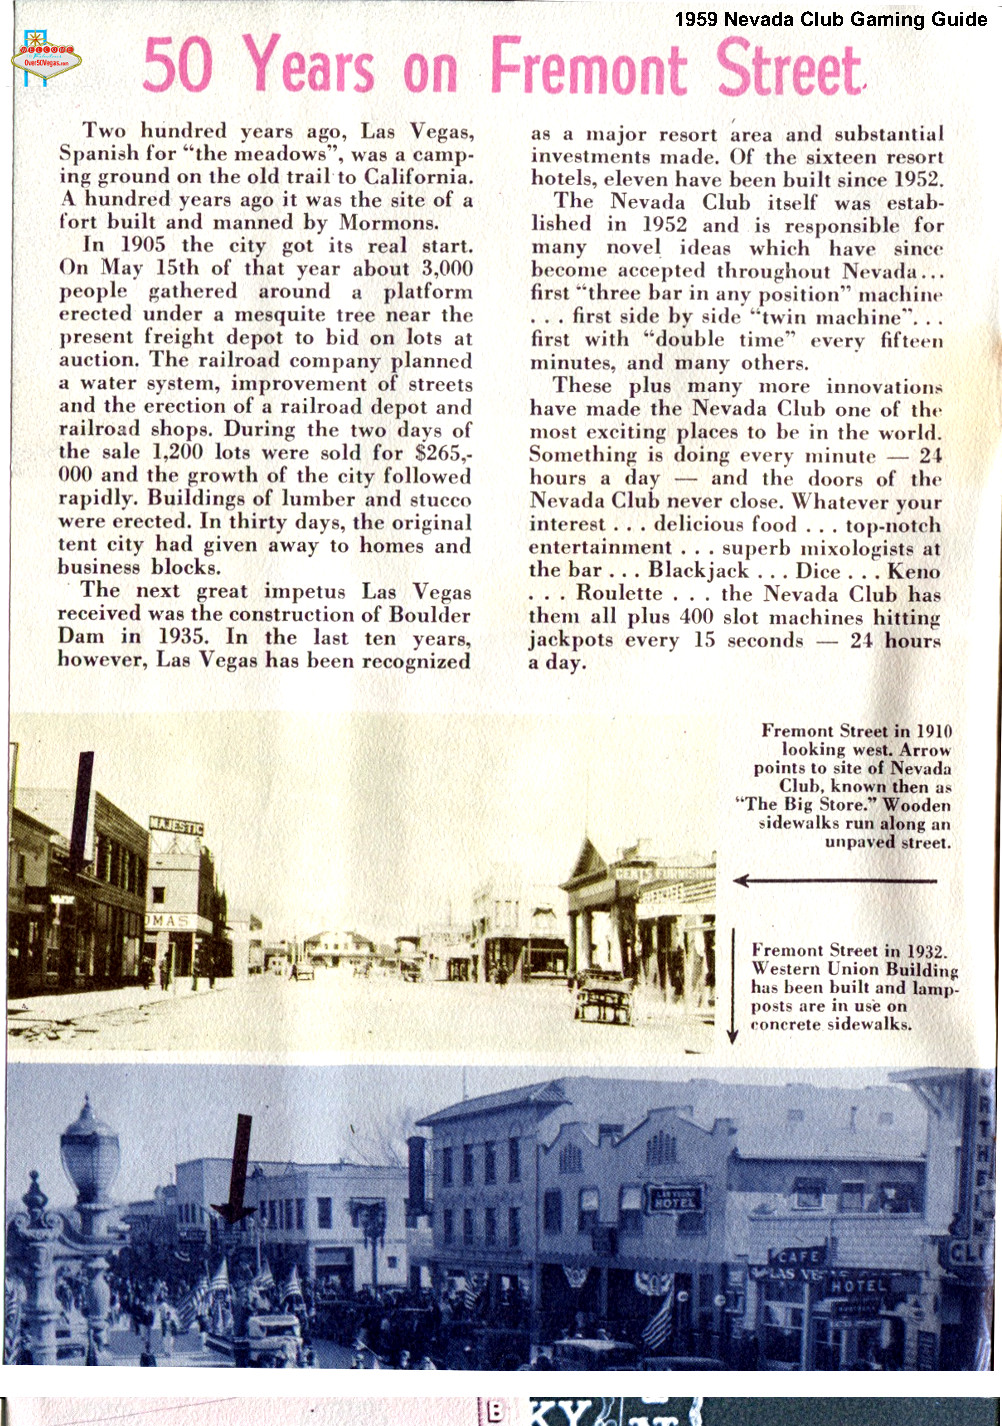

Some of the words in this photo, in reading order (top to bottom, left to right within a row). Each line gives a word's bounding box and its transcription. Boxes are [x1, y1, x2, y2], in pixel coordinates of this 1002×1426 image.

[142, 35, 213, 93] 50
[242, 32, 375, 94] Years
[403, 52, 458, 93] on
[491, 34, 688, 97] Fremont
[716, 35, 863, 97] Street
[82, 121, 126, 138] Two
[141, 120, 226, 139] hundred
[240, 127, 293, 144] years
[307, 127, 347, 143] ago,
[362, 122, 395, 139] Las
[410, 121, 475, 144] Vegas,
[553, 191, 594, 208] The
[610, 191, 685, 210] Nevada
[702, 192, 751, 211] Club
[769, 193, 816, 211] itself
[834, 200, 871, 211] was
[887, 192, 945, 211] estab-
[59, 441, 90, 459] the
[102, 441, 140, 460] sale
[153, 442, 204, 460] 1,200
[215, 442, 251, 460] lots
[261, 448, 309, 460] were
[321, 443, 361, 461] sold
[373, 443, 404, 461] for
[415, 443, 473, 462] $265,-
[762, 722, 834, 738] Fremont
[840, 723, 889, 739] Street
[894, 723, 911, 738] in
[917, 723, 953, 739] 1910
[782, 741, 846, 759] looking
[853, 744, 893, 757] west.
[899, 742, 950, 757] Arrow
[151, 816, 204, 835] MAJESTIC
[752, 960, 820, 976] Western
[828, 960, 879, 976] Union
[886, 961, 959, 982] Building
[655, 1198, 696, 1208] HOTEL
[778, 1251, 819, 1263] CAFE
[831, 1279, 888, 1293] HOTEL
